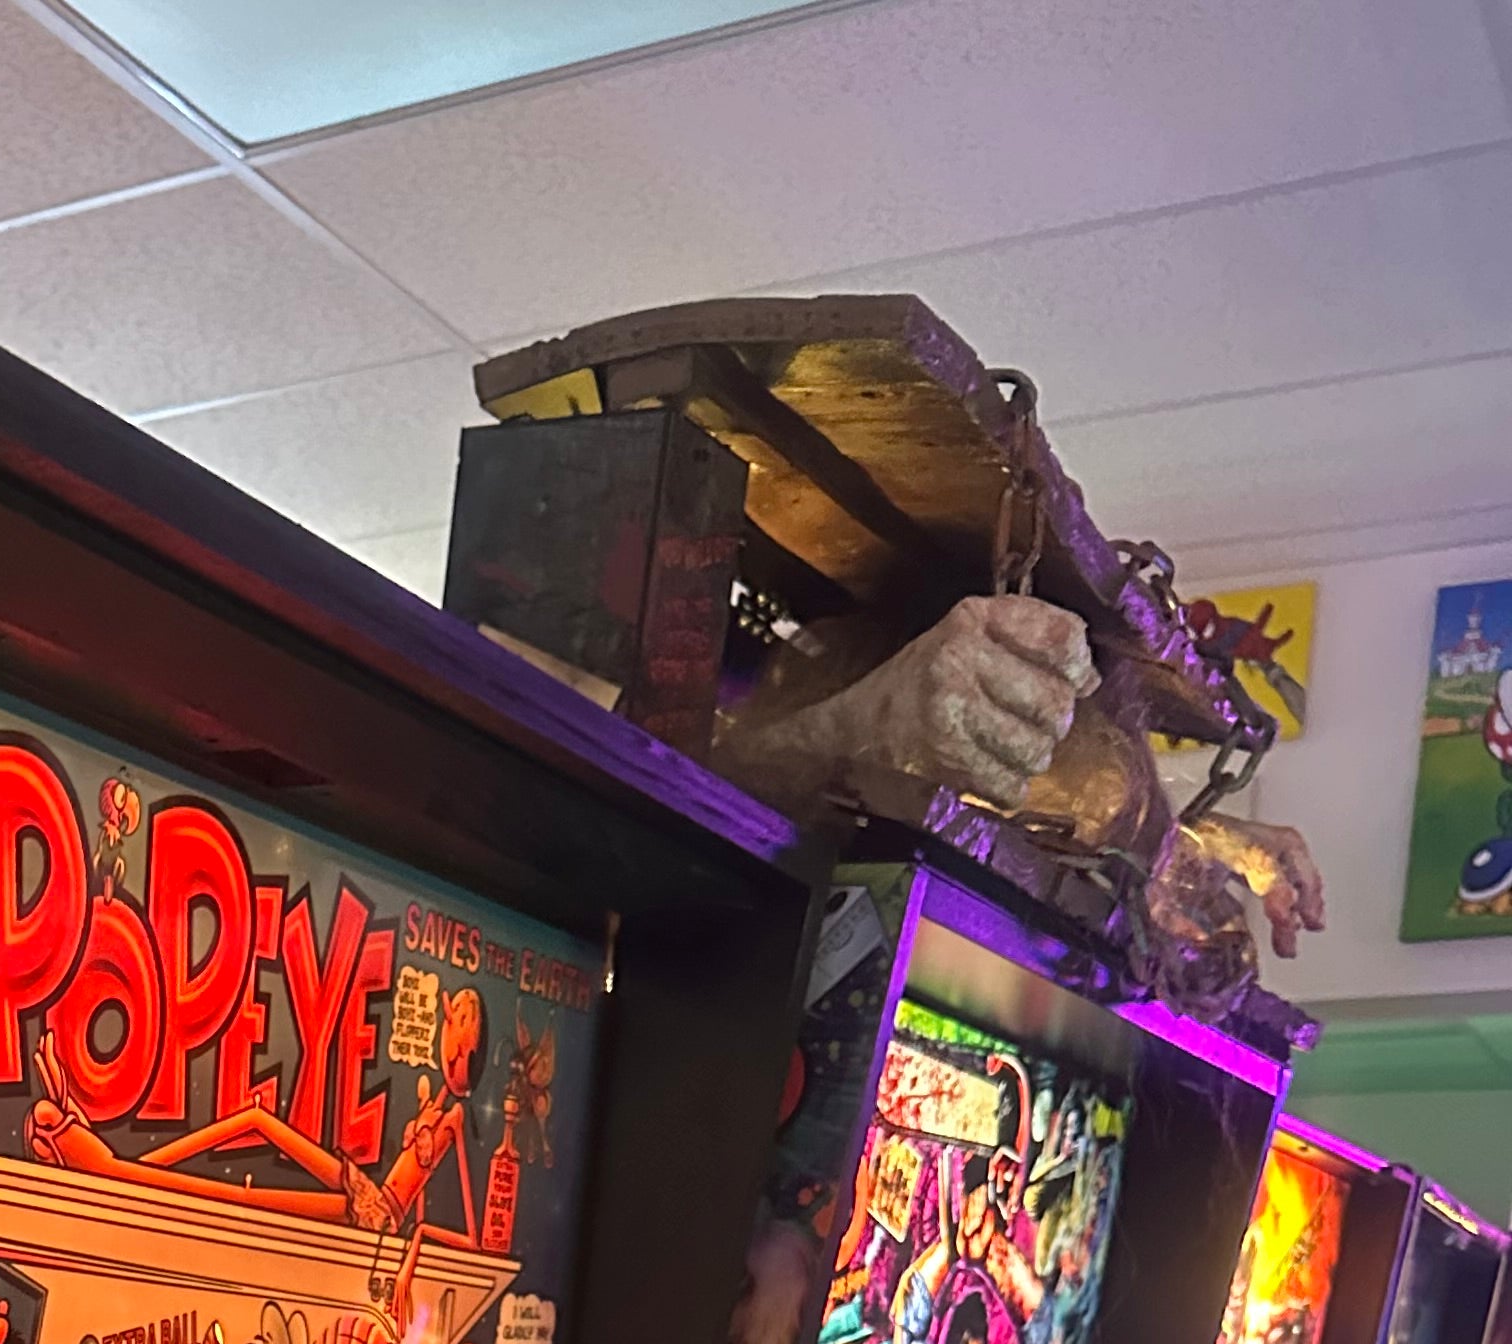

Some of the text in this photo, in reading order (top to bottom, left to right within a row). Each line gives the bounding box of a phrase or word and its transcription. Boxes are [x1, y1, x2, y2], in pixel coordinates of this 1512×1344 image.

[405, 903, 589, 1011] SAVES THE EARTH
